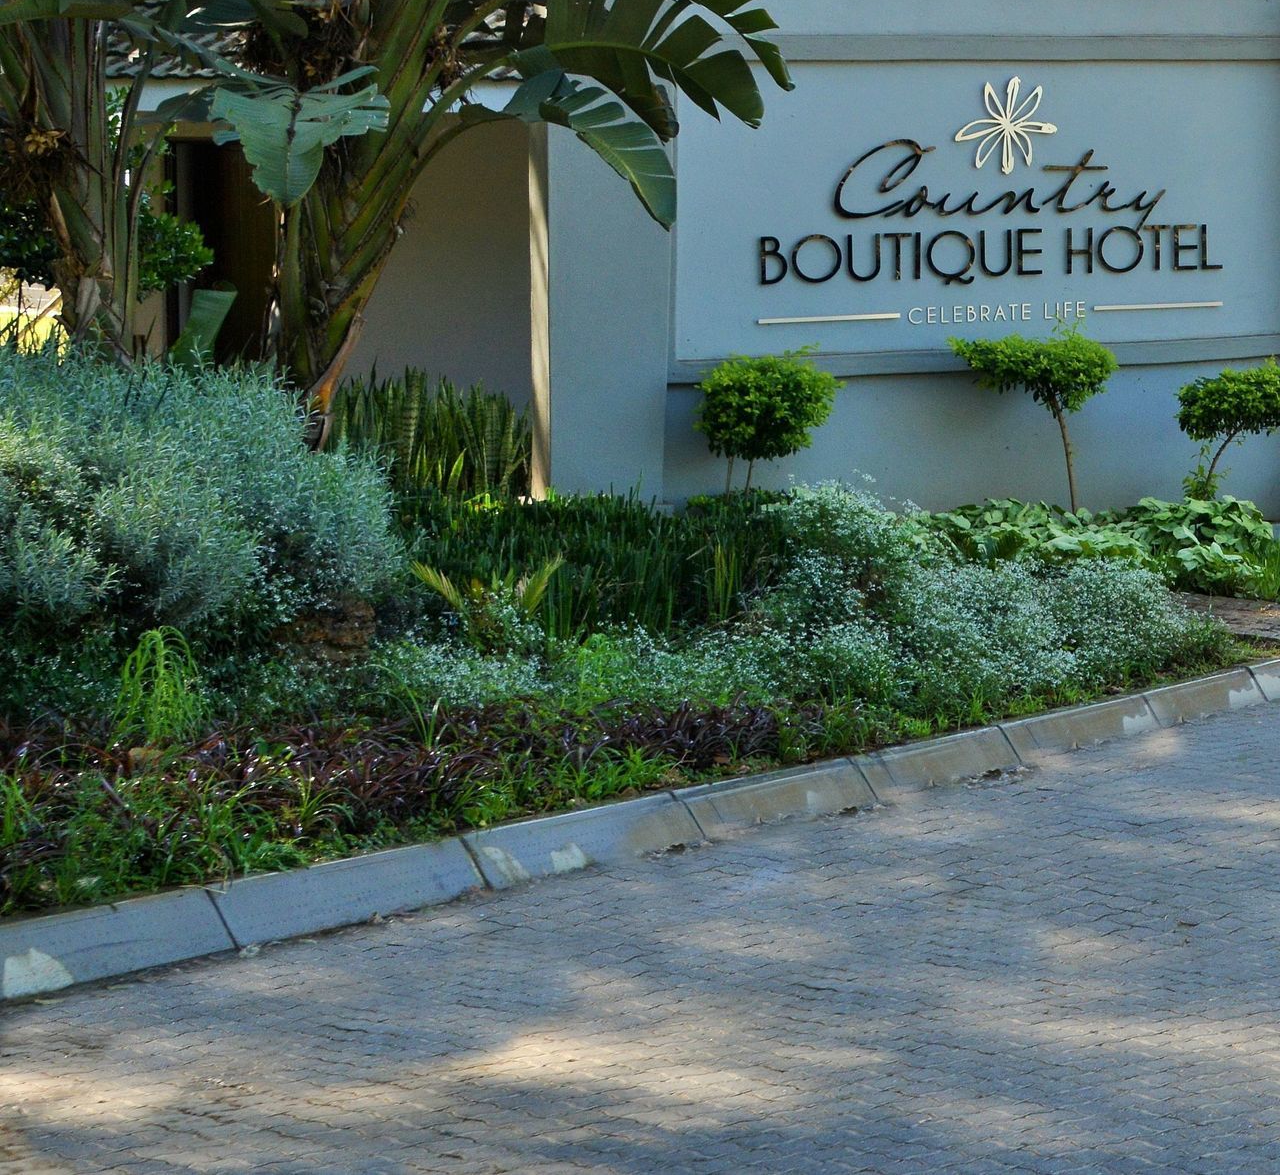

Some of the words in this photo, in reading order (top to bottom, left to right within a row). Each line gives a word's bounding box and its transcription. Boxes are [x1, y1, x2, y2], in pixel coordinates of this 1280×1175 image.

[833, 138, 1166, 229] Country
[760, 227, 1043, 286] BOUTIQUE
[1066, 224, 1223, 275] HOTEL
[908, 302, 1031, 325] CELEBRATE
[1044, 300, 1086, 321] LIFE
